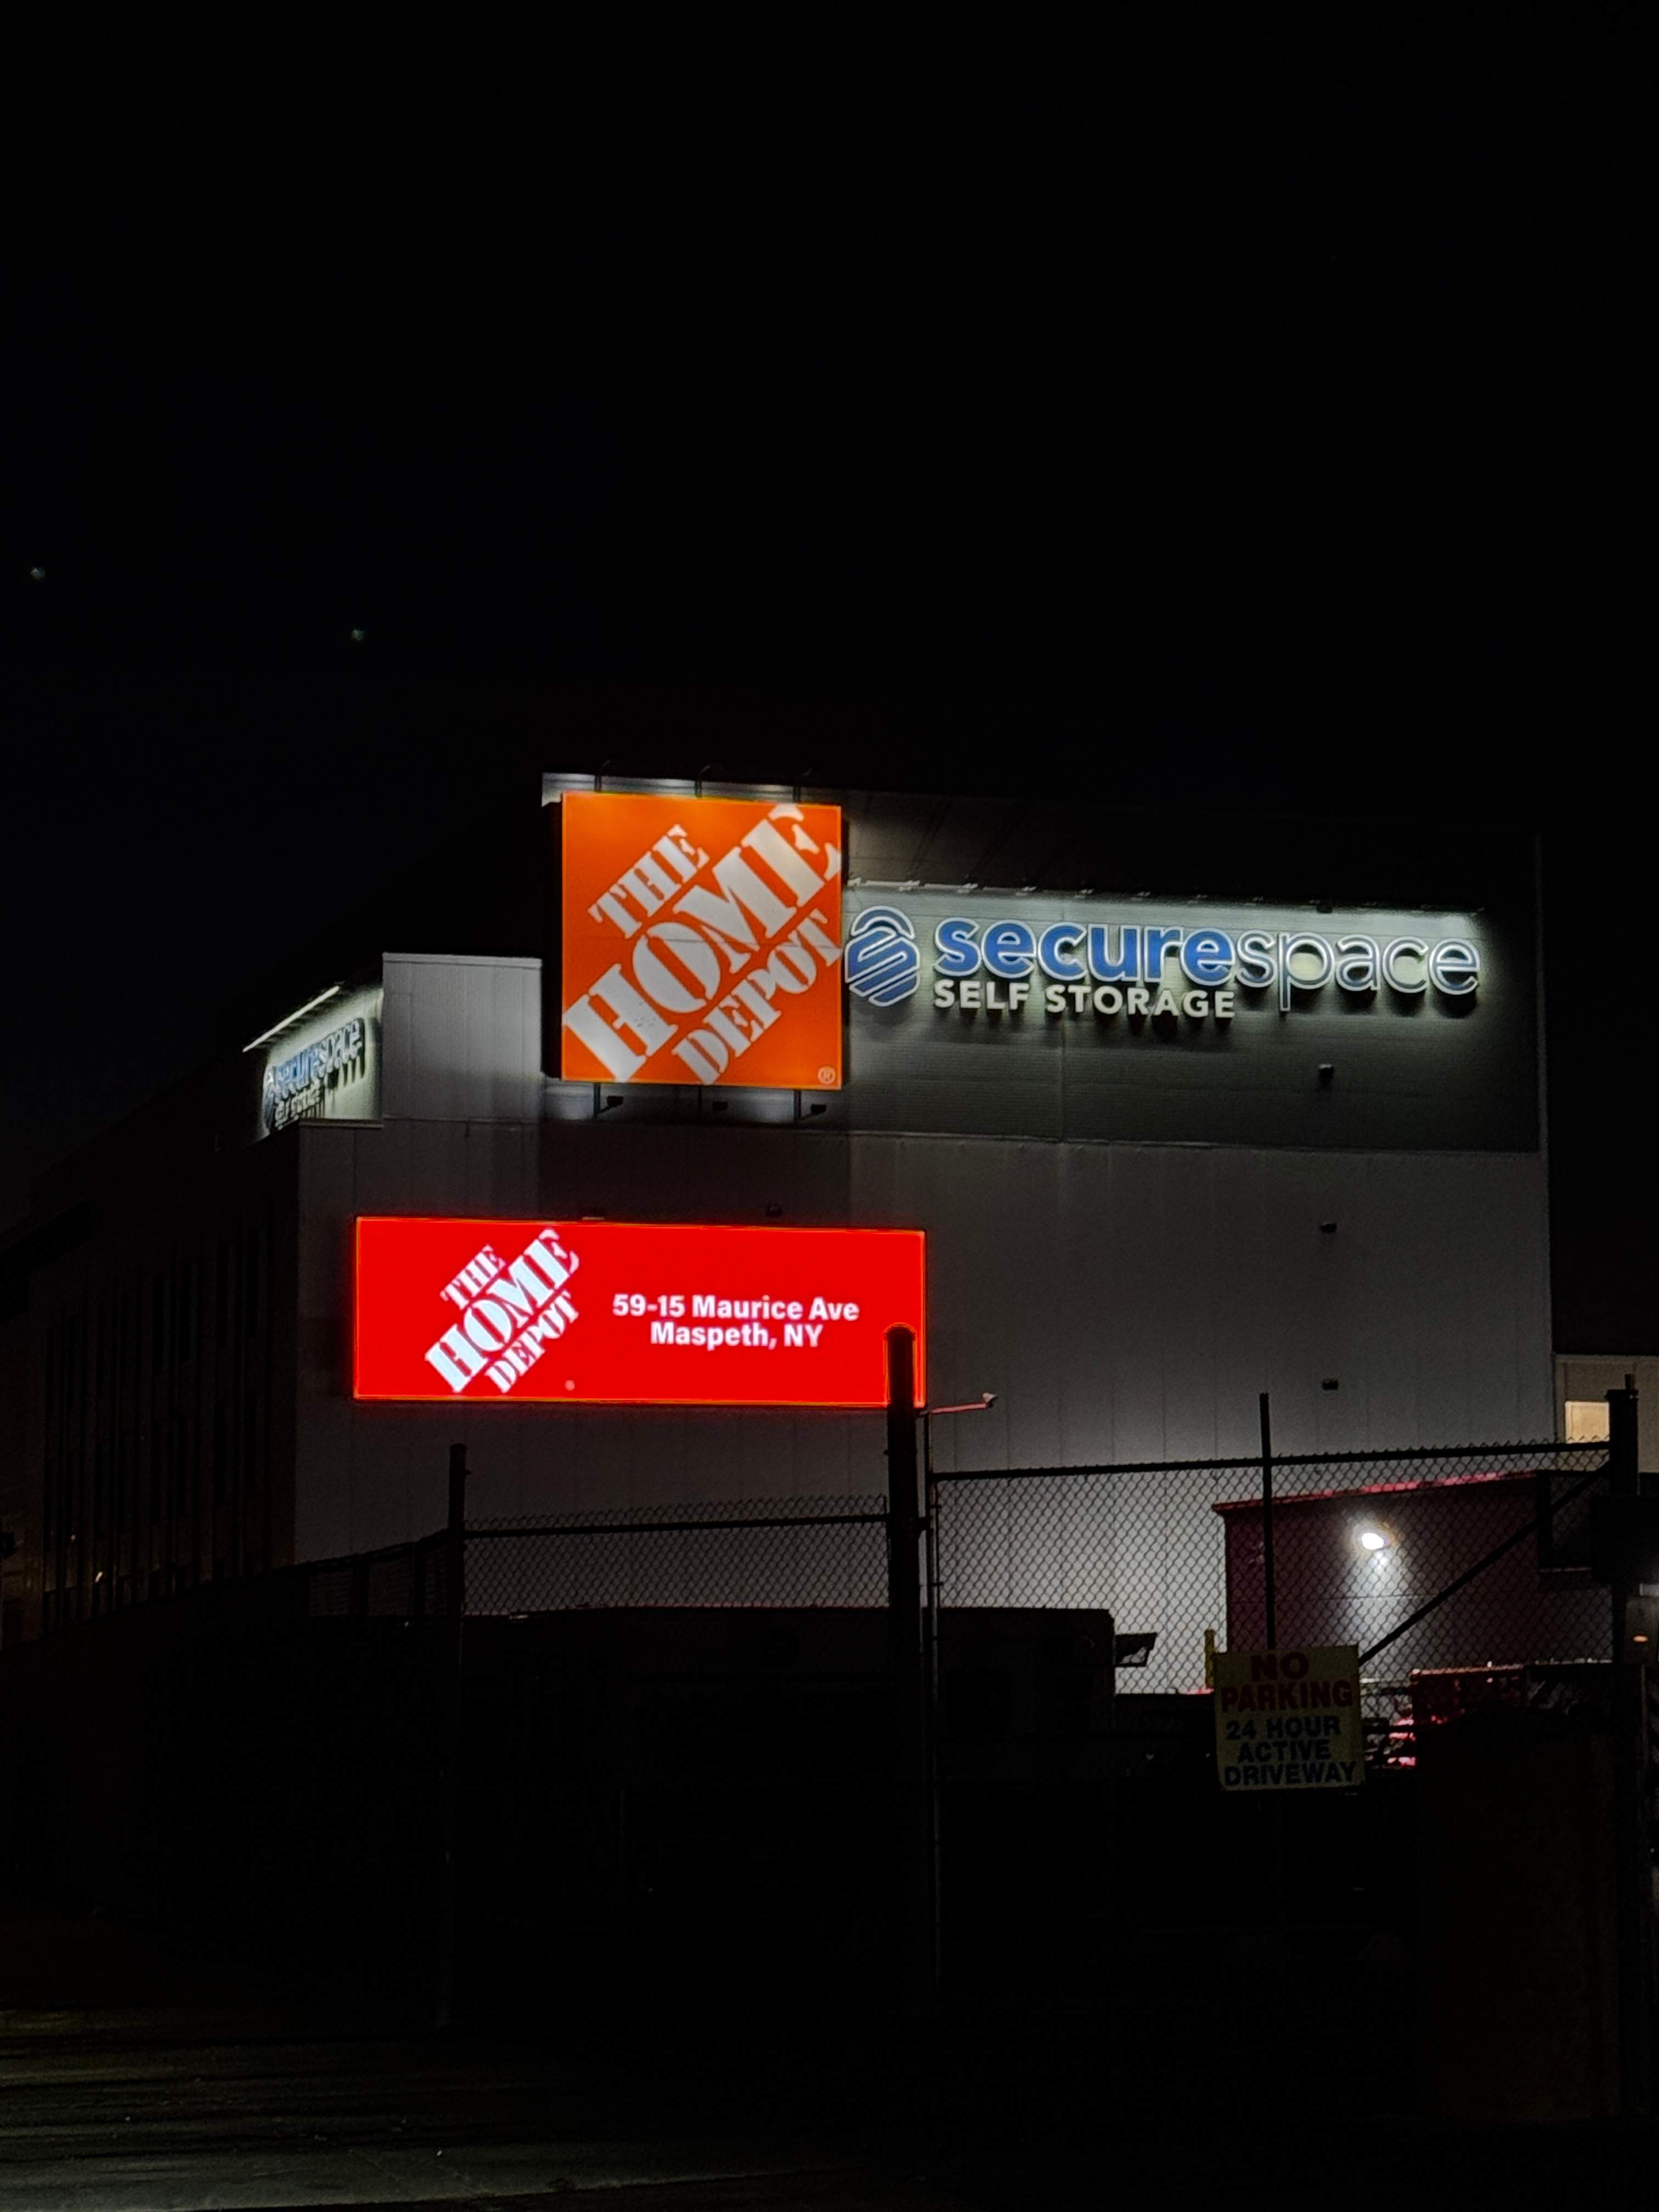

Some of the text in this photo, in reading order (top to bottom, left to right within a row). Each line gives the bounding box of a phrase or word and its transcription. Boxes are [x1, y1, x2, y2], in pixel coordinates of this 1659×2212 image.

[588, 825, 709, 938] THE
[563, 803, 841, 1082] HOME
[933, 917, 1481, 1012] securespace
[672, 909, 842, 1085] DEPOT
[934, 980, 1235, 1020] SELF STORAGE
[439, 1243, 506, 1311] THE
[424, 1227, 580, 1393] HOME
[612, 1293, 860, 1321] 59-15 Maurice Ave
[484, 1290, 579, 1394] DEPOT
[651, 1321, 823, 1352] Maspeth, NY
[1251, 1652, 1308, 1681] NO
[1221, 1681, 1352, 1712] PARKING
[1226, 1716, 1341, 1740] 24 HOUR
[1238, 1740, 1331, 1762] ACTIVE
[1224, 1762, 1356, 1785] DRIVEWAY
